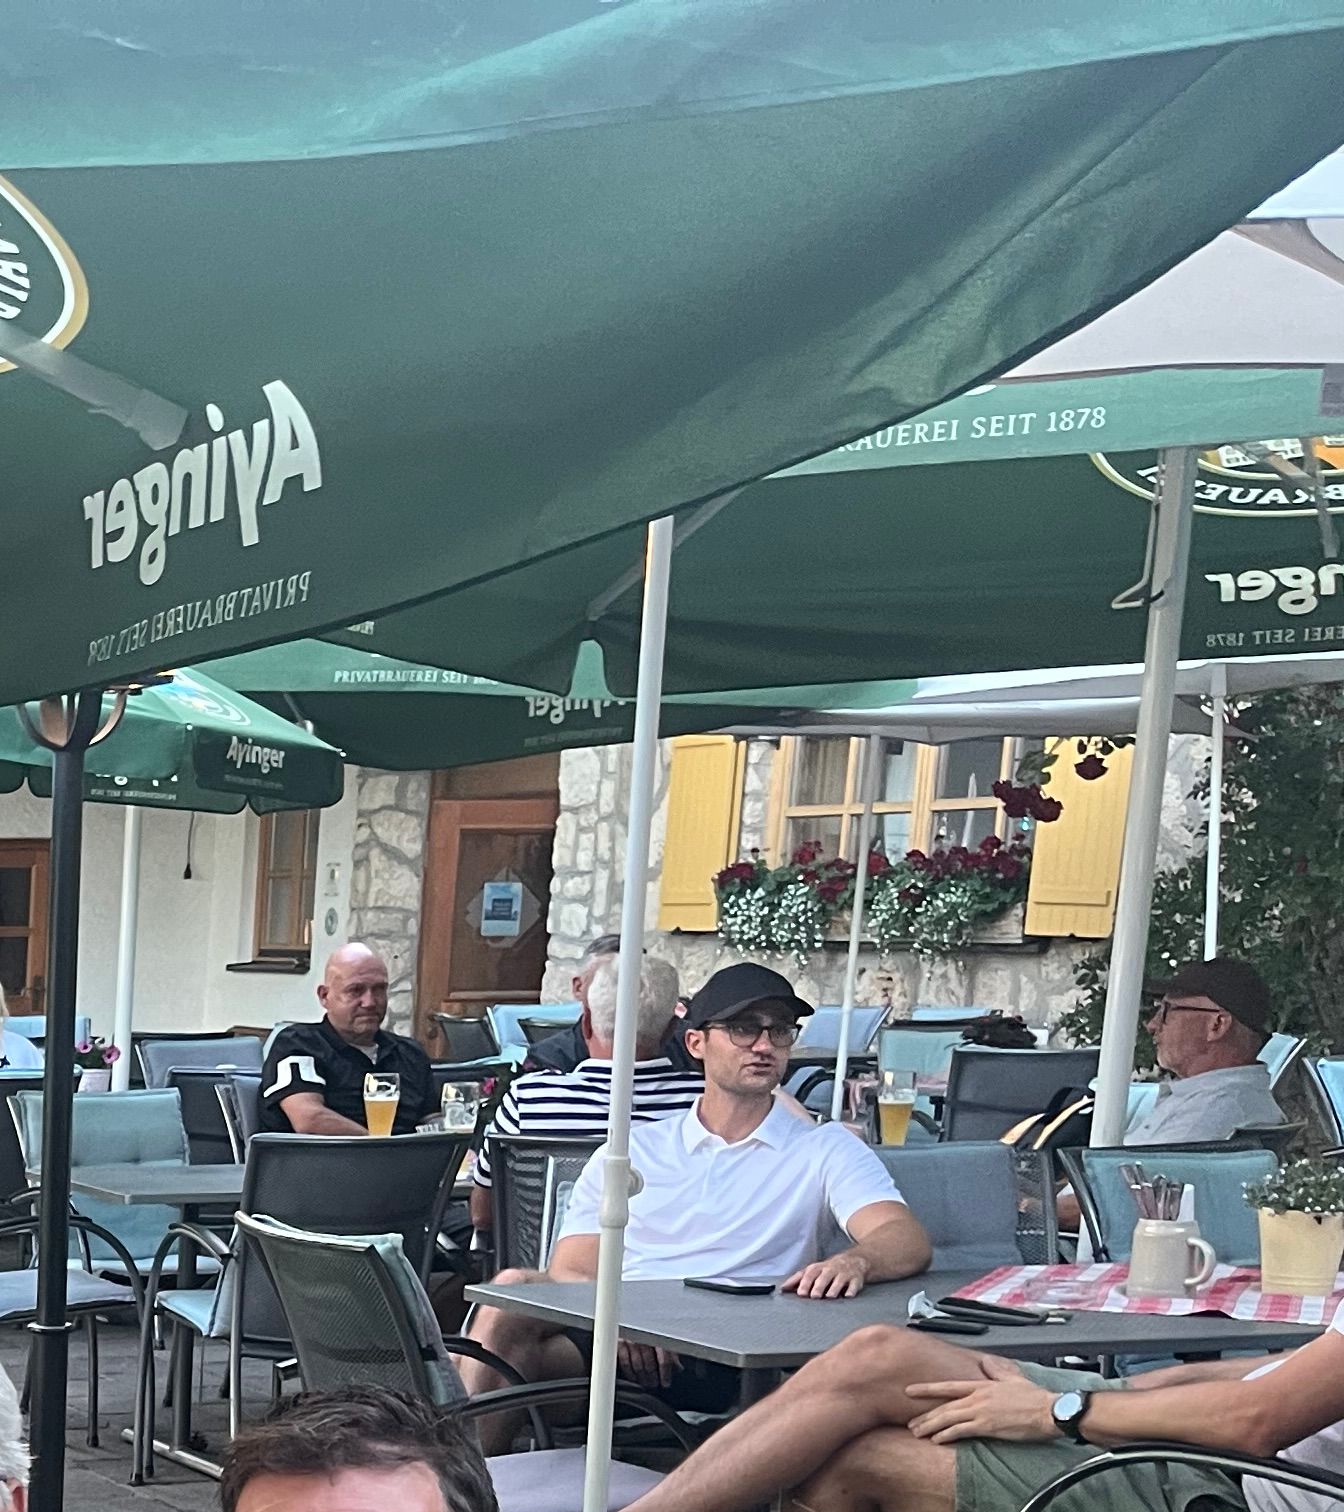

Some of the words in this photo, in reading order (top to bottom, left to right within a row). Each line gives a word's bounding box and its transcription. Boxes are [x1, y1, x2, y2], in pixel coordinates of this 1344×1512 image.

[970, 412, 1037, 439] SEIT
[1046, 406, 1107, 432] 1878
[226, 736, 286, 774] Ayinger
